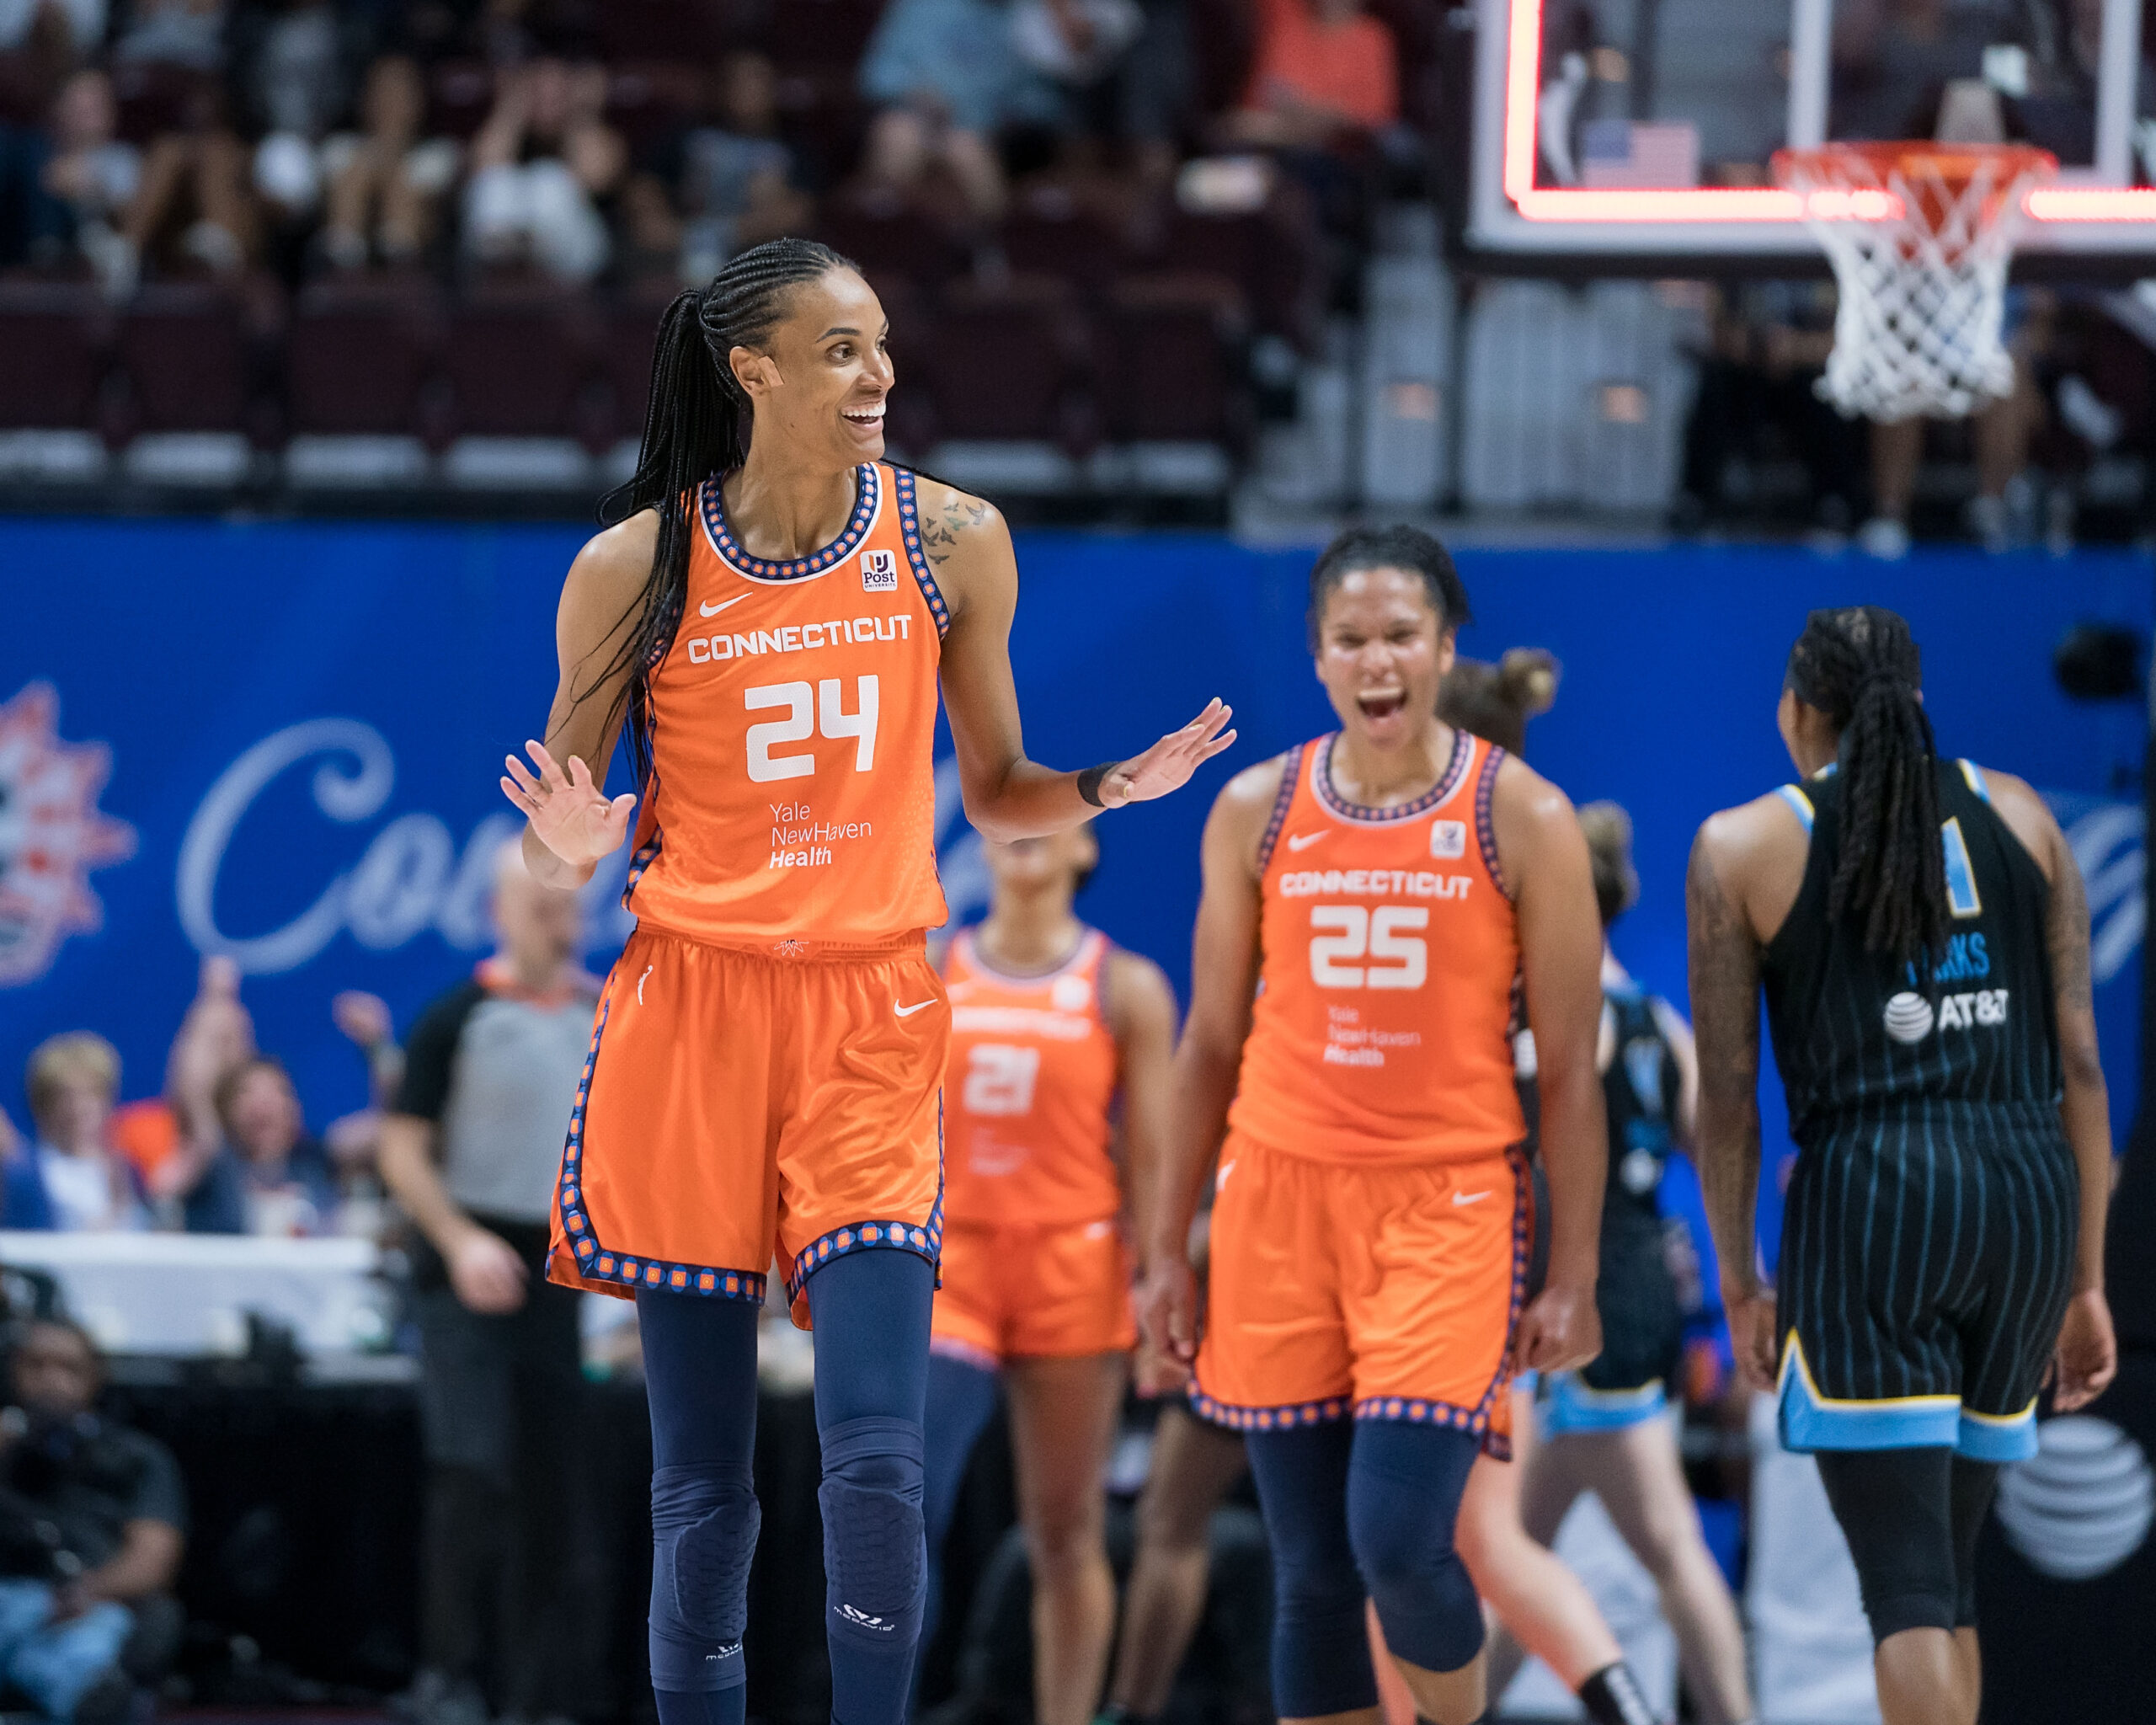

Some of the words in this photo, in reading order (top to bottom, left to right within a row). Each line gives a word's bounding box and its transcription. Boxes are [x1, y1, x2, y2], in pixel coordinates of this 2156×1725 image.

[863, 571, 895, 584] Post
[687, 615, 912, 664] CONNECTICUT
[744, 674, 879, 782] 24
[769, 801, 811, 822] Yale
[771, 821, 873, 846] NewHaven
[769, 846, 832, 869] Health
[1278, 869, 1474, 900] CONNECTICUT
[1309, 905, 1429, 990] 25
[1937, 989, 2009, 1032] AT&T
